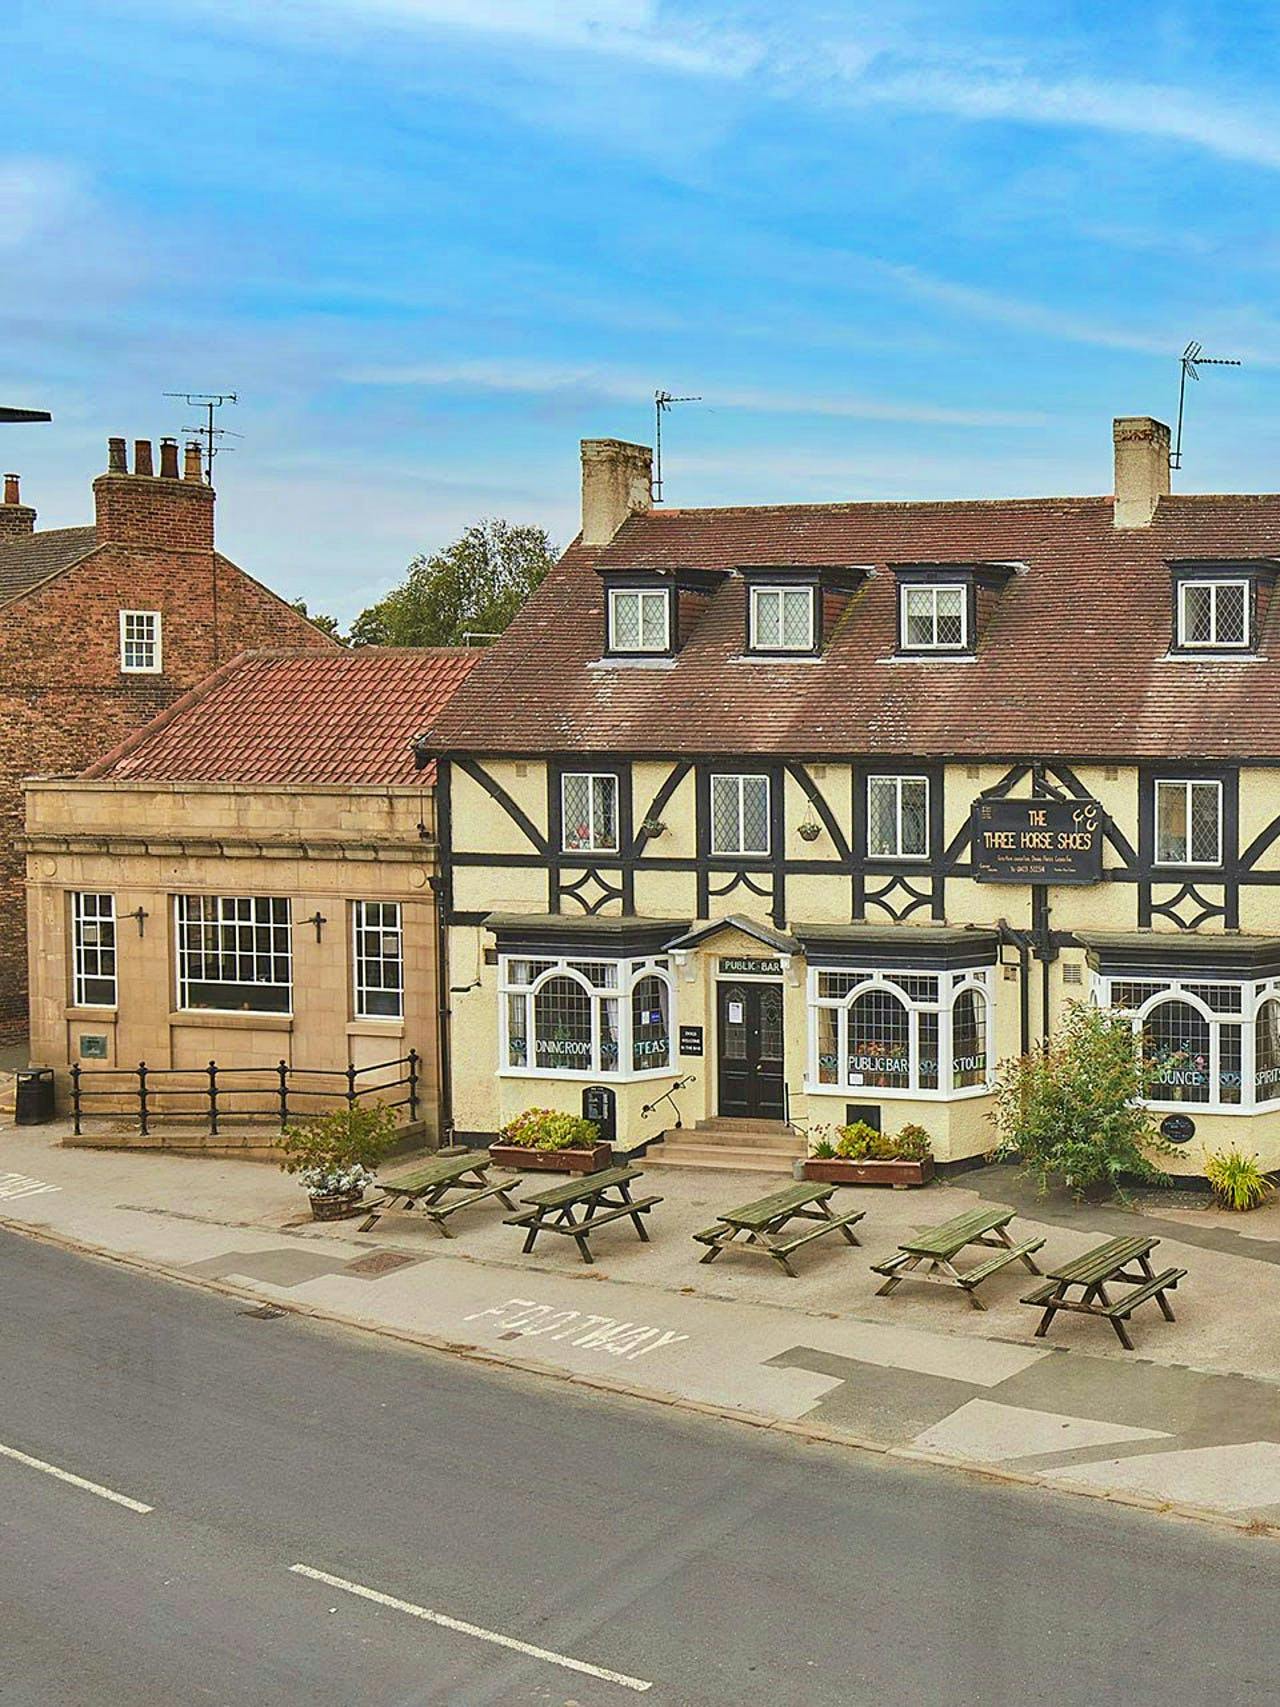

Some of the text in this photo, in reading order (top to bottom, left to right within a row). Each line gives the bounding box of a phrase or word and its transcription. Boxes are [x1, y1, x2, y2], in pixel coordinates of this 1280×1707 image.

[1028, 810, 1047, 826] THE
[983, 832, 1092, 850] THREE HORSE SHOES
[725, 960, 780, 972] PUBLIC BAR
[637, 1039, 666, 1055] TEAS
[953, 1055, 985, 1072] STOUT
[462, 1298, 690, 1361] FOOTWAY
